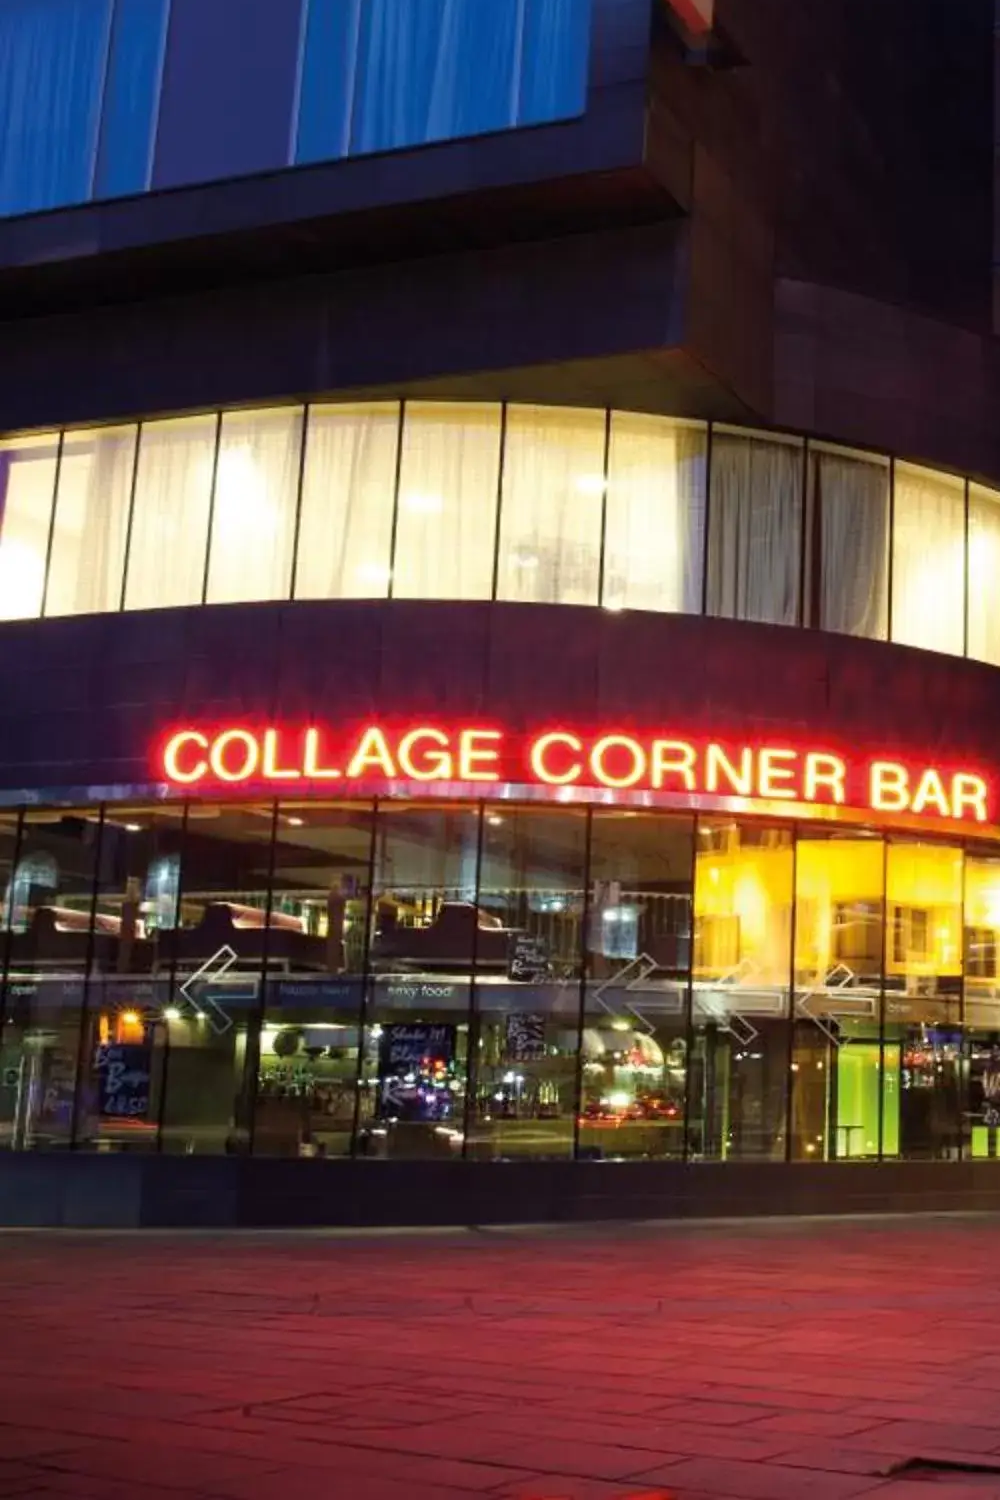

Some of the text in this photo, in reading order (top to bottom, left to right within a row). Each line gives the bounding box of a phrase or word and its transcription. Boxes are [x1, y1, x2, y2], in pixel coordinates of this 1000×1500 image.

[162, 725, 990, 822] COLLAGE CORNER BAR
